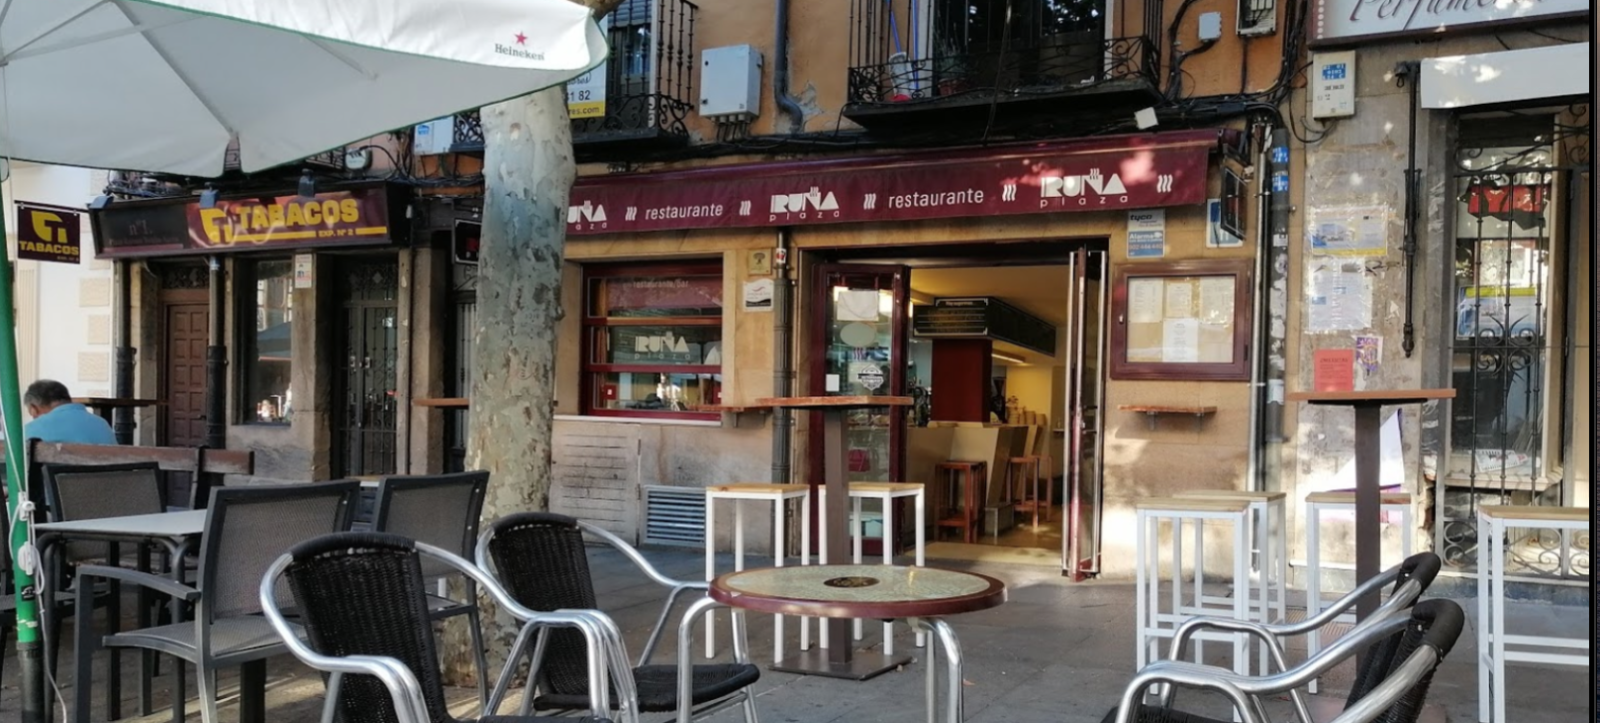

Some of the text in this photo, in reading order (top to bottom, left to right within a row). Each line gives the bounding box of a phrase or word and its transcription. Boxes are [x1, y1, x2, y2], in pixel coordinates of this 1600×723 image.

[494, 42, 545, 61] Heineken
[578, 90, 591, 101] 82
[569, 107, 600, 115] res.com
[1041, 168, 1127, 197] IRUÑA
[770, 186, 839, 213] IRUÑA
[889, 188, 984, 209] restaurante
[1040, 195, 1128, 209] plaza
[237, 198, 360, 230] TABACOS
[567, 200, 607, 223] UÑA
[645, 203, 723, 220] restaurante
[769, 210, 840, 222] plaza
[318, 229, 336, 238] EXP.
[347, 228, 354, 236] 2
[575, 222, 607, 231] aza
[19, 241, 79, 256] TABACOS
[635, 331, 690, 353] IRUÑA
[634, 352, 691, 360] plaza
